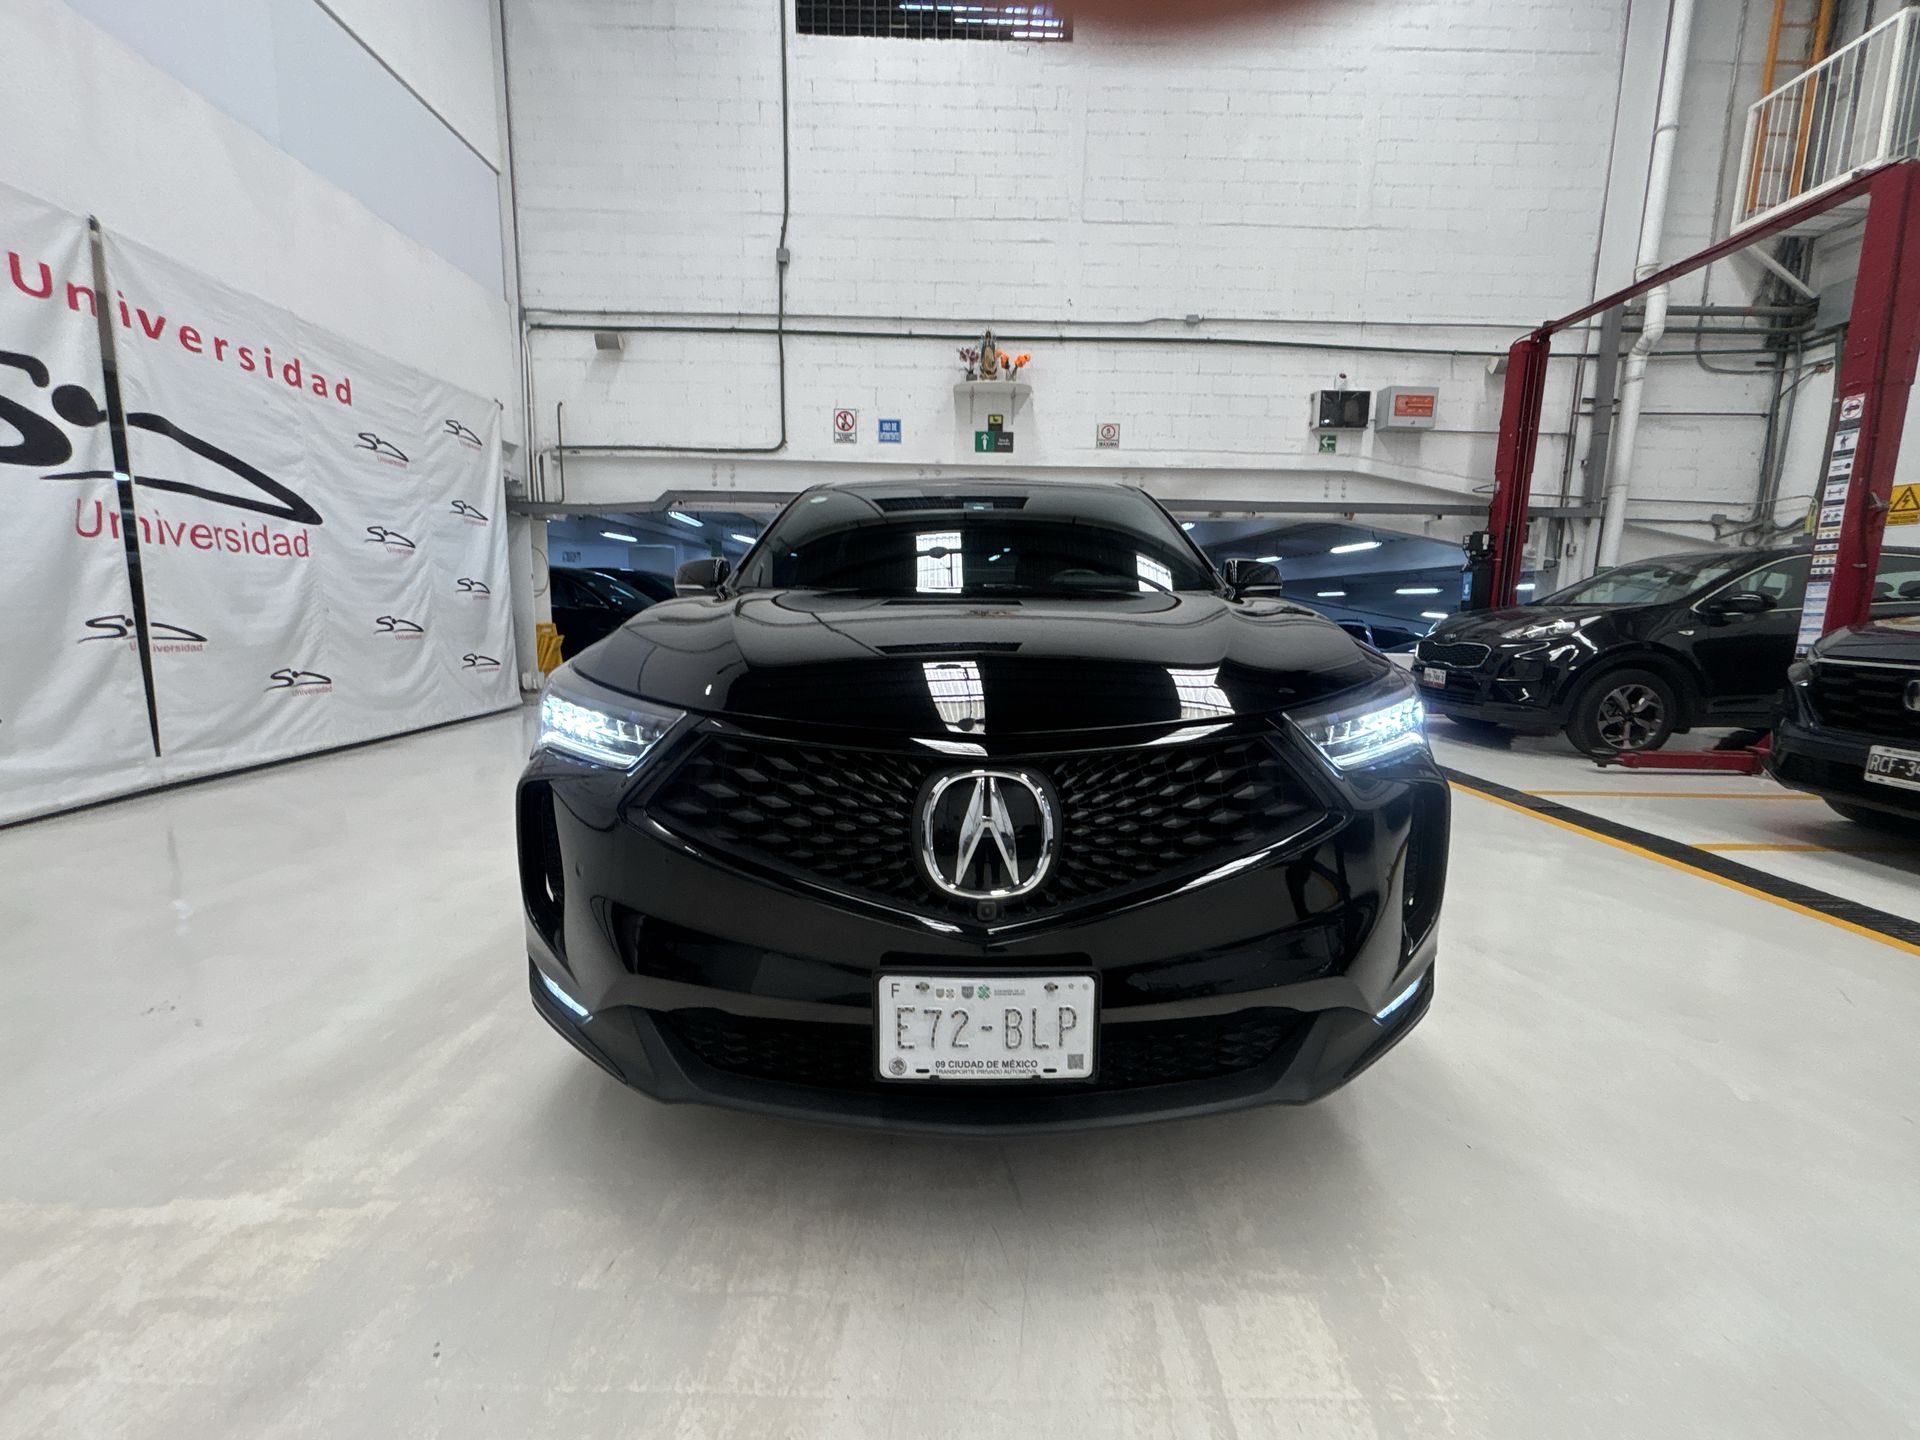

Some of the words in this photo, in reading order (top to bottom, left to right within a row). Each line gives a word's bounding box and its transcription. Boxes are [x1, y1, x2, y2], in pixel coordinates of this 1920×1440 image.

[8, 251, 352, 406] Universidad
[75, 498, 310, 558] Universidad
[129, 641, 203, 652] Uiversidad
[891, 983, 901, 998] F
[897, 1007, 1077, 1050] E72-BLP
[935, 1060, 946, 1069] 09
[948, 1060, 984, 1069] CIUDAD
[986, 1060, 999, 1069] DE
[1001, 1059, 1038, 1069] MÉXICO
